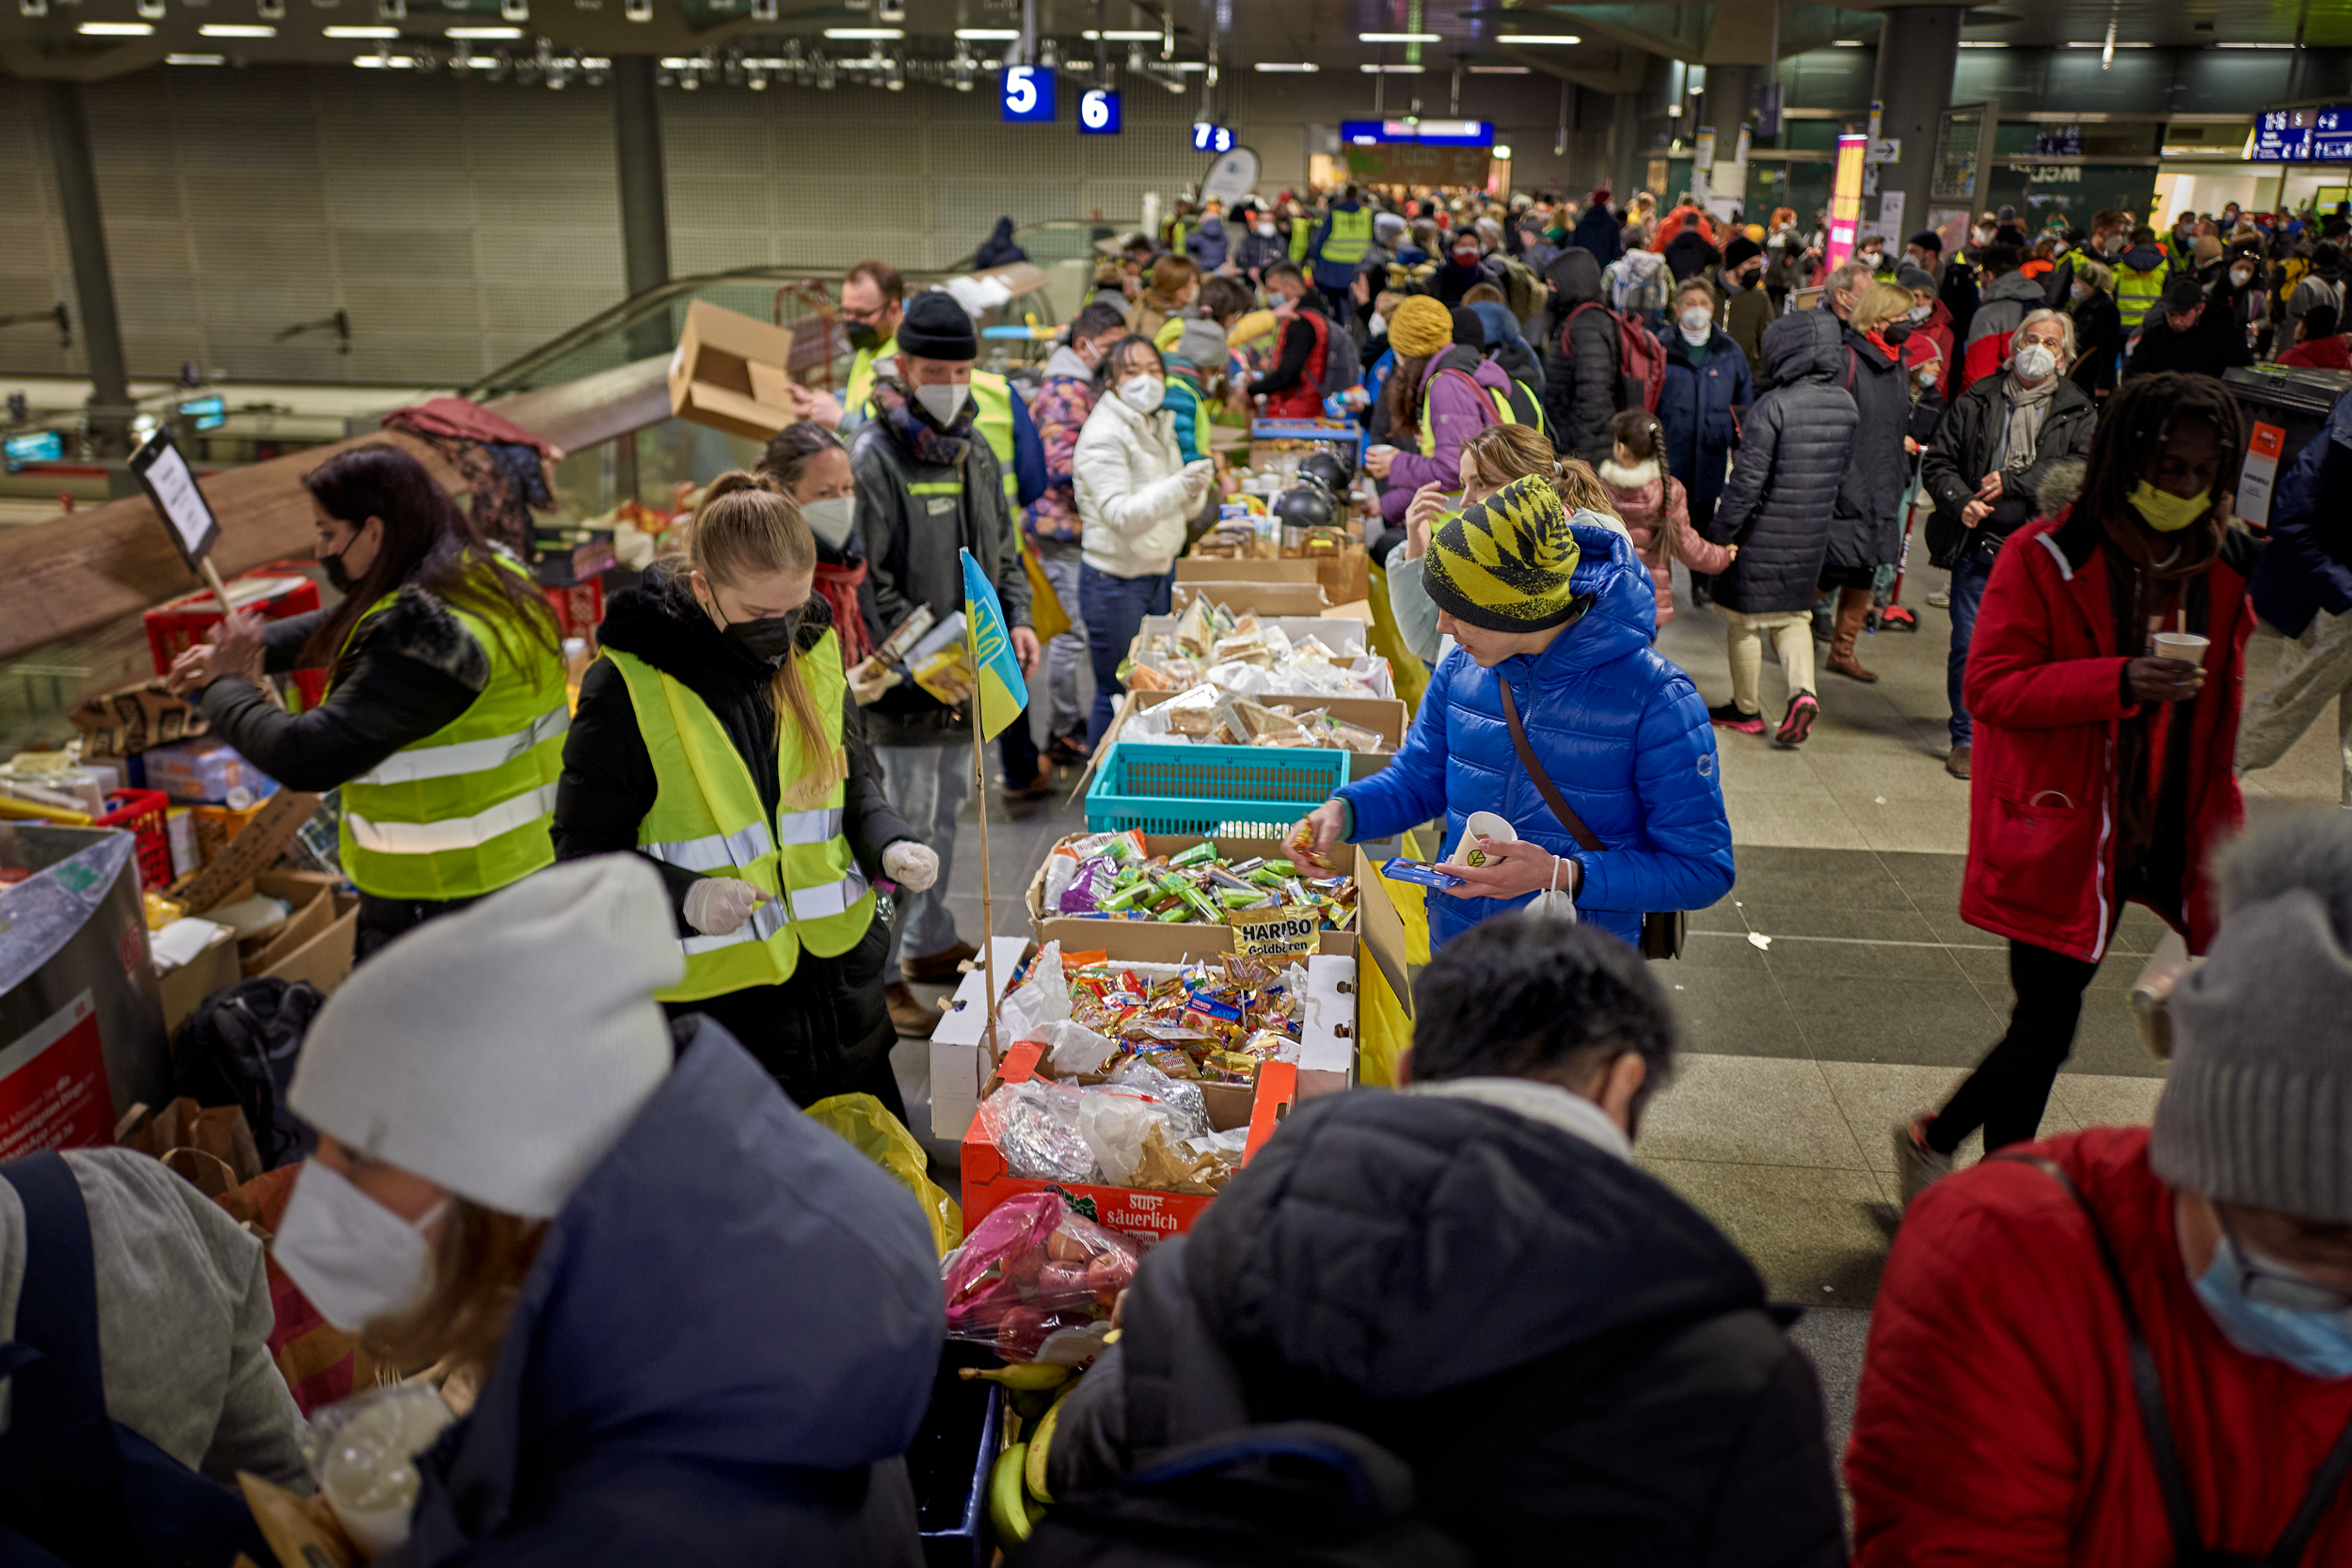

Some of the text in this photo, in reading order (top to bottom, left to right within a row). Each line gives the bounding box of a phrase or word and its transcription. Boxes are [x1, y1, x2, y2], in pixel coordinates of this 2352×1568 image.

[1006, 66, 1037, 113] 5
[1081, 89, 1108, 128] 6
[1194, 122, 1212, 149] 7
[1243, 919, 1312, 942] HARIBO
[1107, 1209, 1177, 1230] säuerlich
